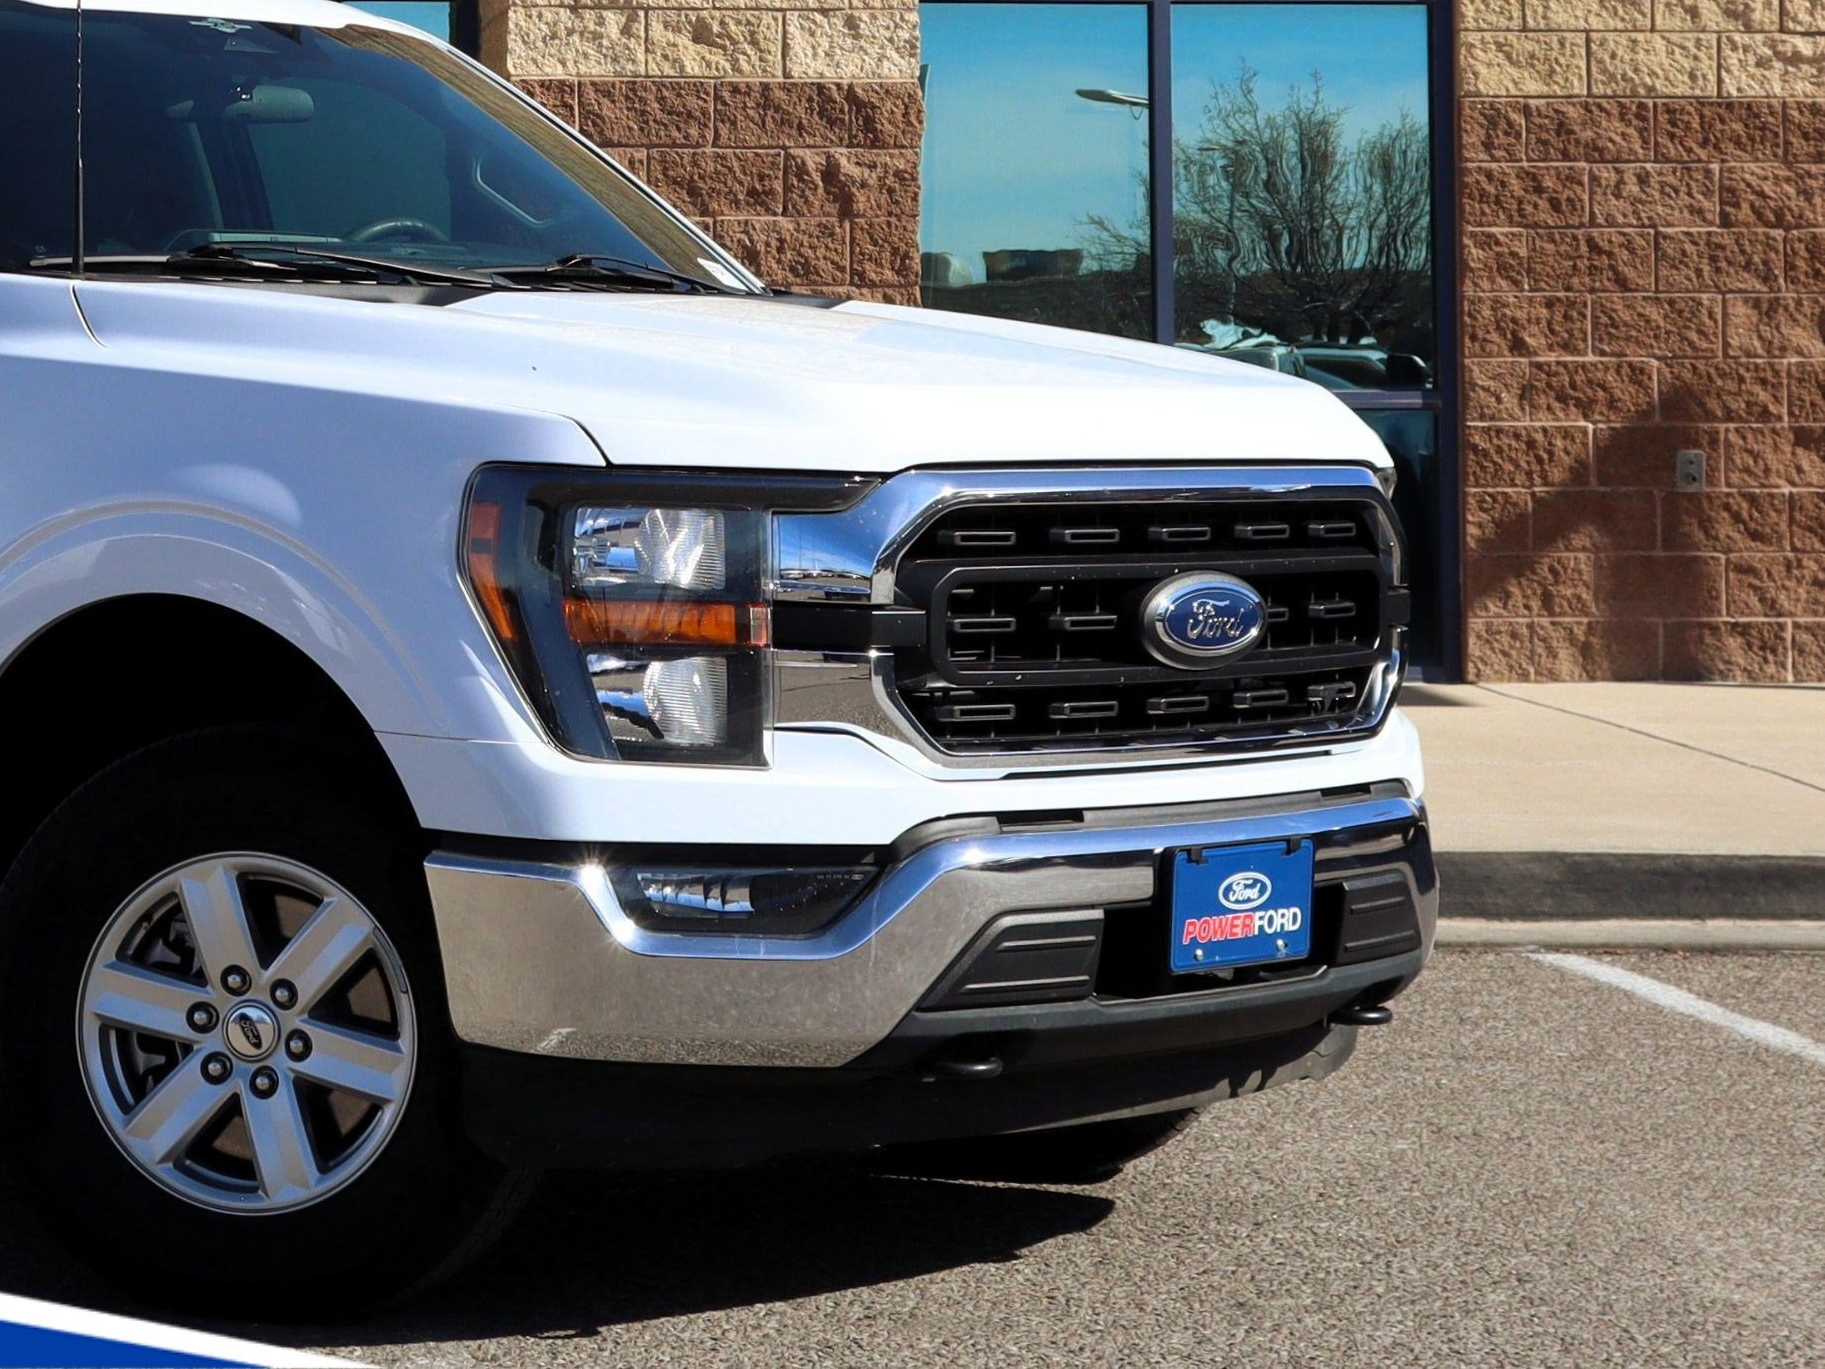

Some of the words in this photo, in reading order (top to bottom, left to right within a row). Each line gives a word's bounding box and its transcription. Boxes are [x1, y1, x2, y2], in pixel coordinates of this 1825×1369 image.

[1187, 598, 1244, 639] Ford
[1229, 878, 1262, 902] Ford
[1182, 907, 1302, 945] POWERFORD
